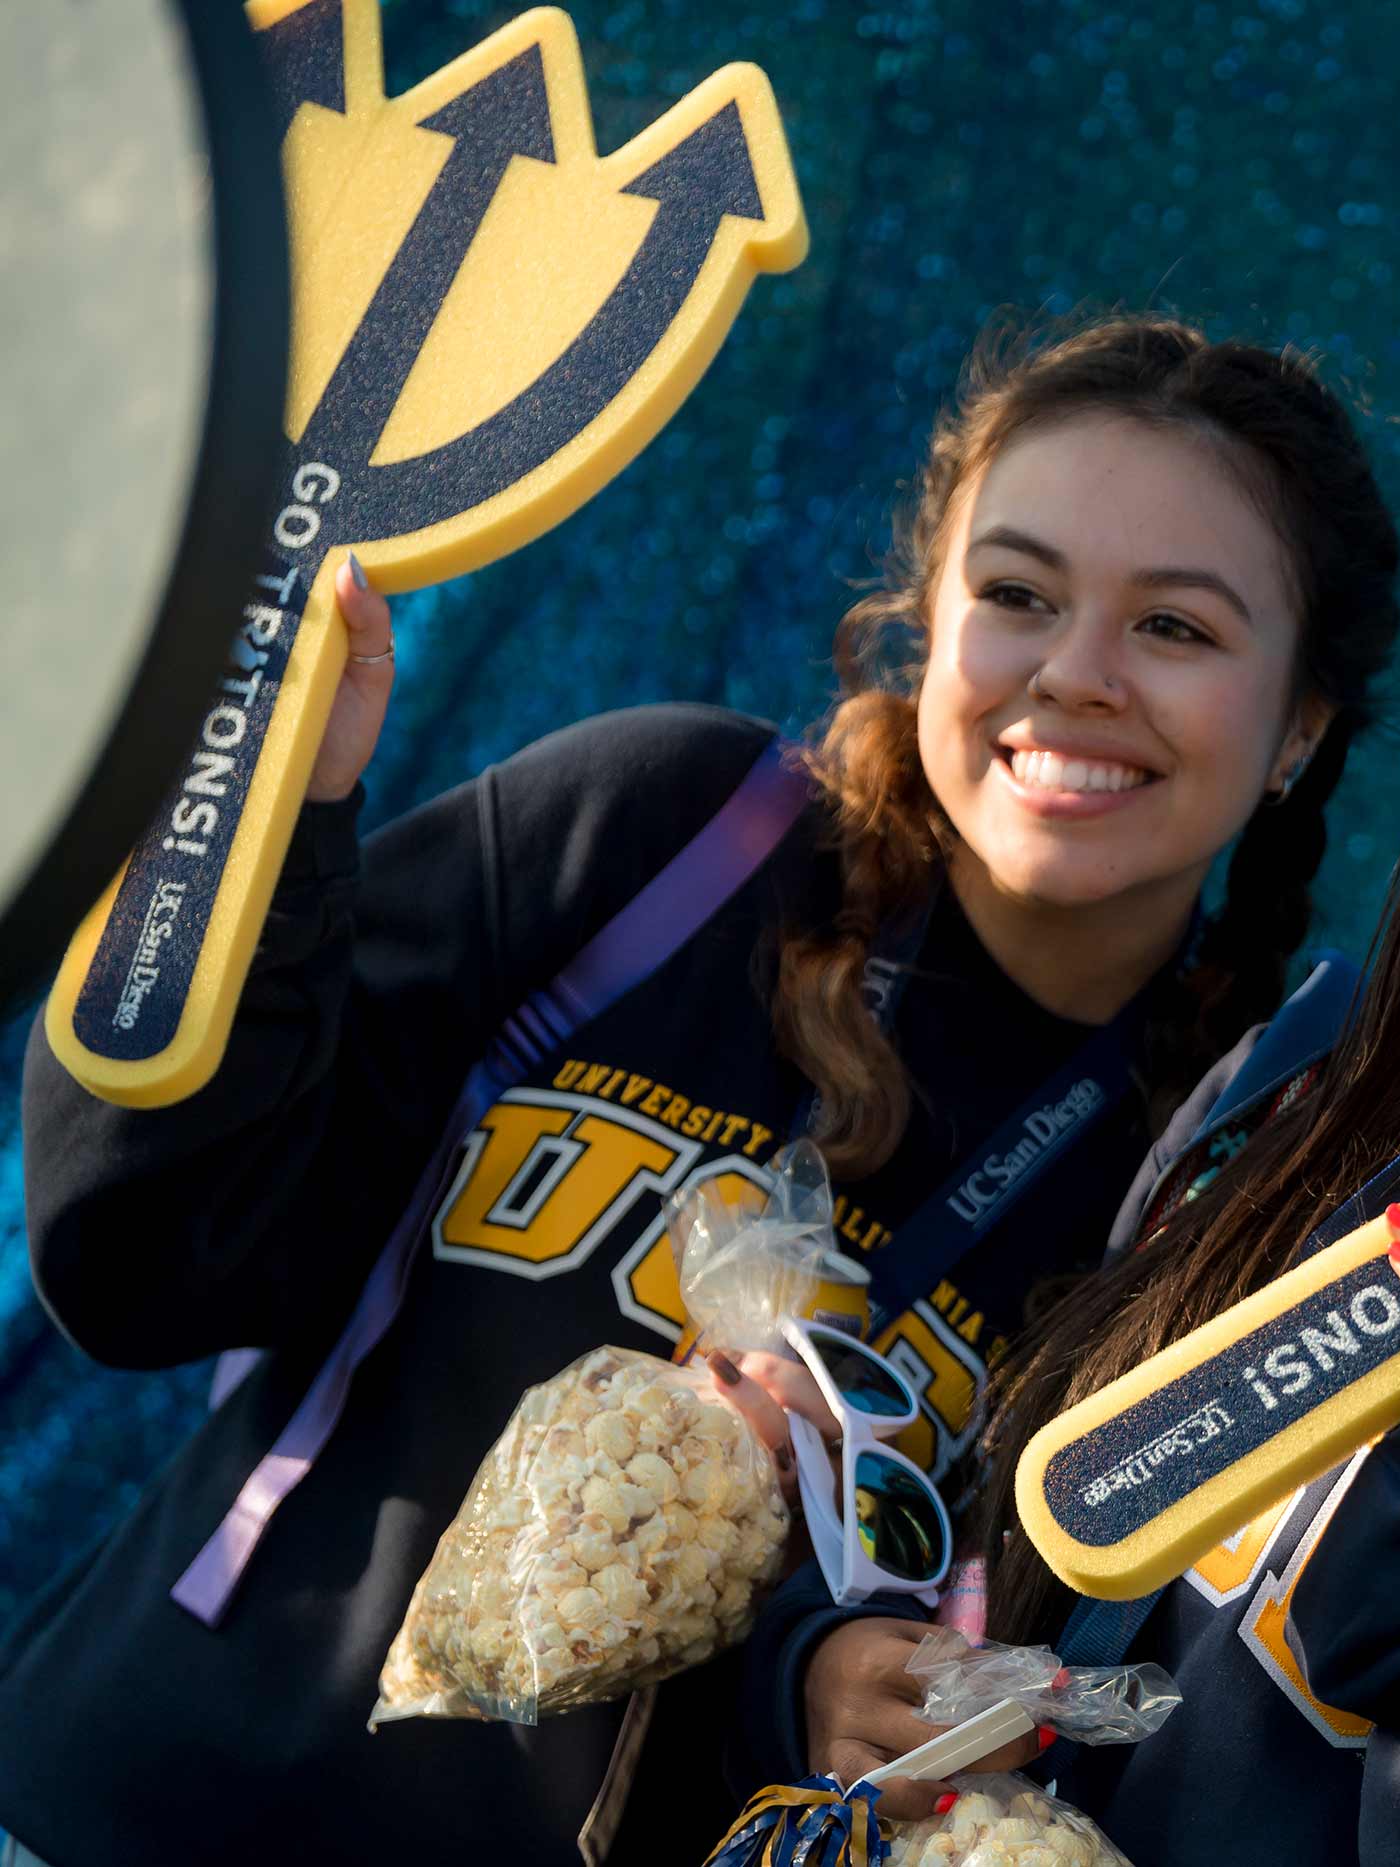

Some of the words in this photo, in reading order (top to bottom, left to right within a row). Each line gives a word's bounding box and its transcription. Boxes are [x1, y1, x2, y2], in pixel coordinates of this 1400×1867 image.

[272, 462, 342, 551] GO
[153, 883, 188, 921] UC
[139, 919, 173, 964] San
[118, 966, 161, 1029] Diego
[552, 1059, 776, 1156] UNIVERSITY
[946, 1173, 1000, 1223] UC
[982, 1153, 1042, 1188] San
[1021, 1077, 1104, 1145] Diego
[1143, 1427, 1194, 1467] San
[1187, 1406, 1235, 1443] UC
[1084, 1456, 1153, 1507] Diego
